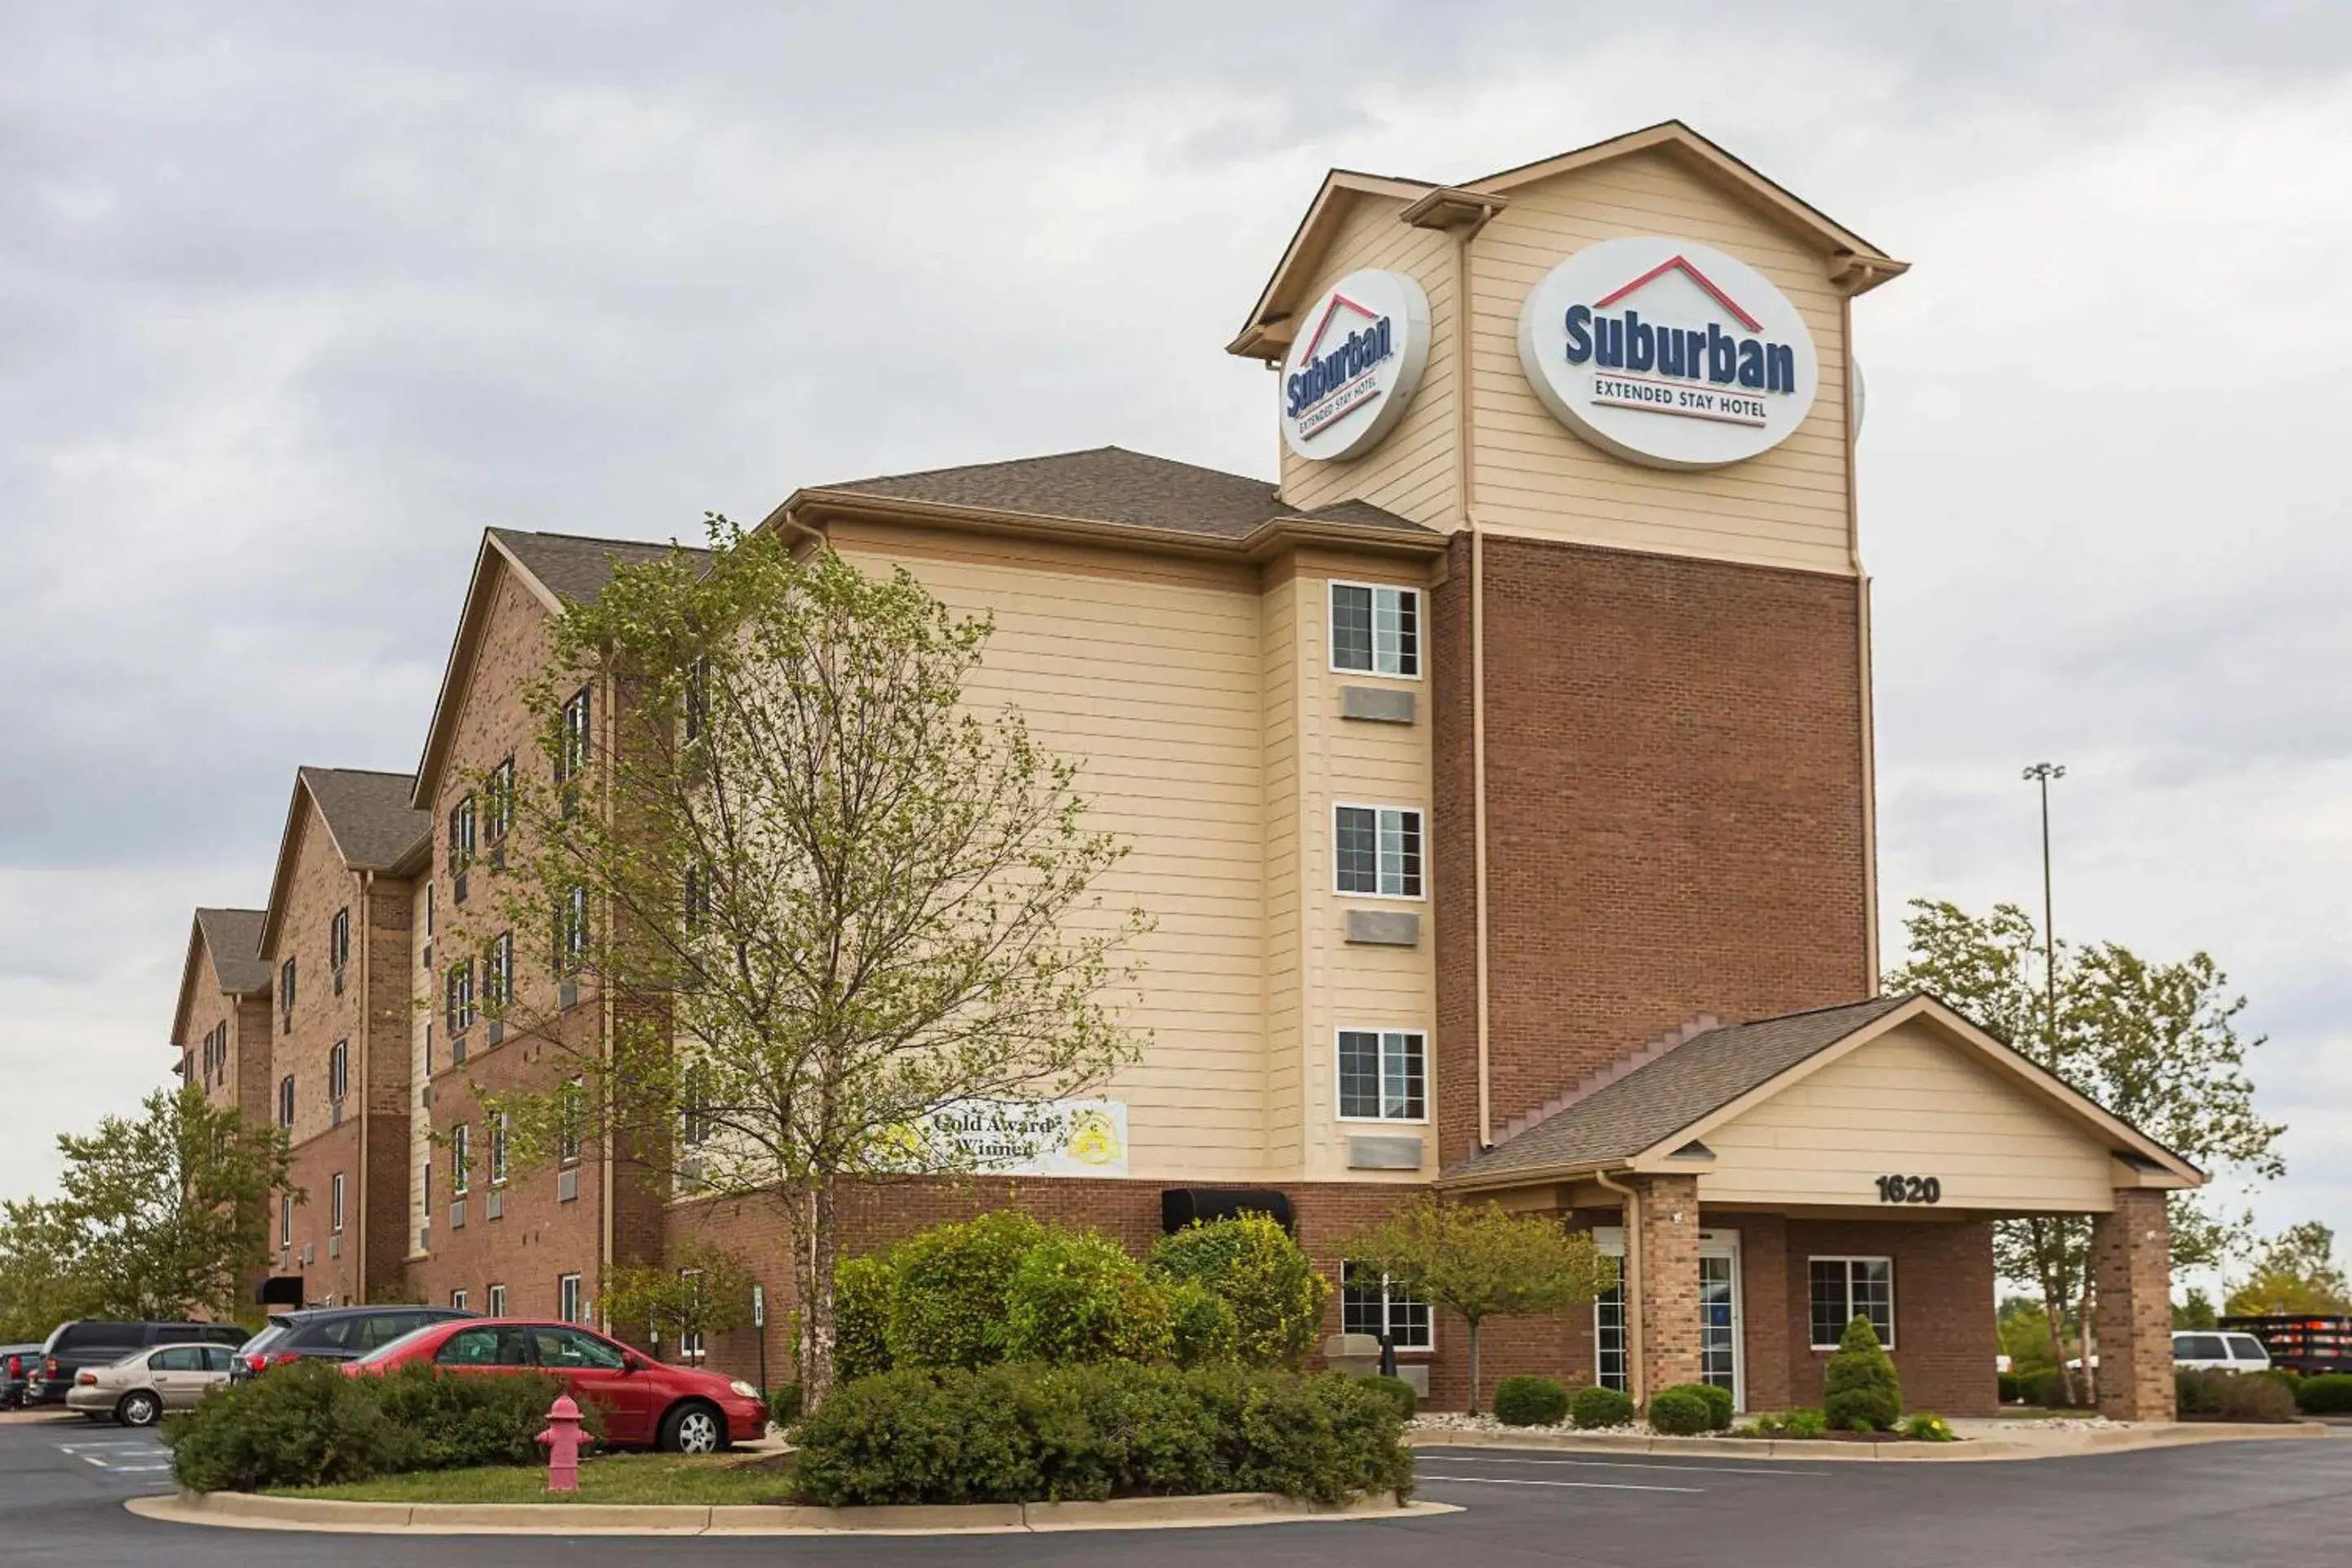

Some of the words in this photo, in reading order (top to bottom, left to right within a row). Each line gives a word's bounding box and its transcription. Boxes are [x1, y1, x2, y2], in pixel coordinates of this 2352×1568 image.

[1287, 316, 1390, 418] Suburban
[1566, 304, 1794, 393] Suburban
[1299, 405, 1333, 434] EXTENDED
[1334, 390, 1352, 410] STAY
[1354, 377, 1376, 399] HOTEL
[1596, 380, 1672, 403] EXTENDED
[1680, 391, 1713, 410] STAY
[1720, 397, 1766, 418] HOTEL
[934, 1115, 982, 1133] Gold
[1874, 1174, 1940, 1203] 1620
